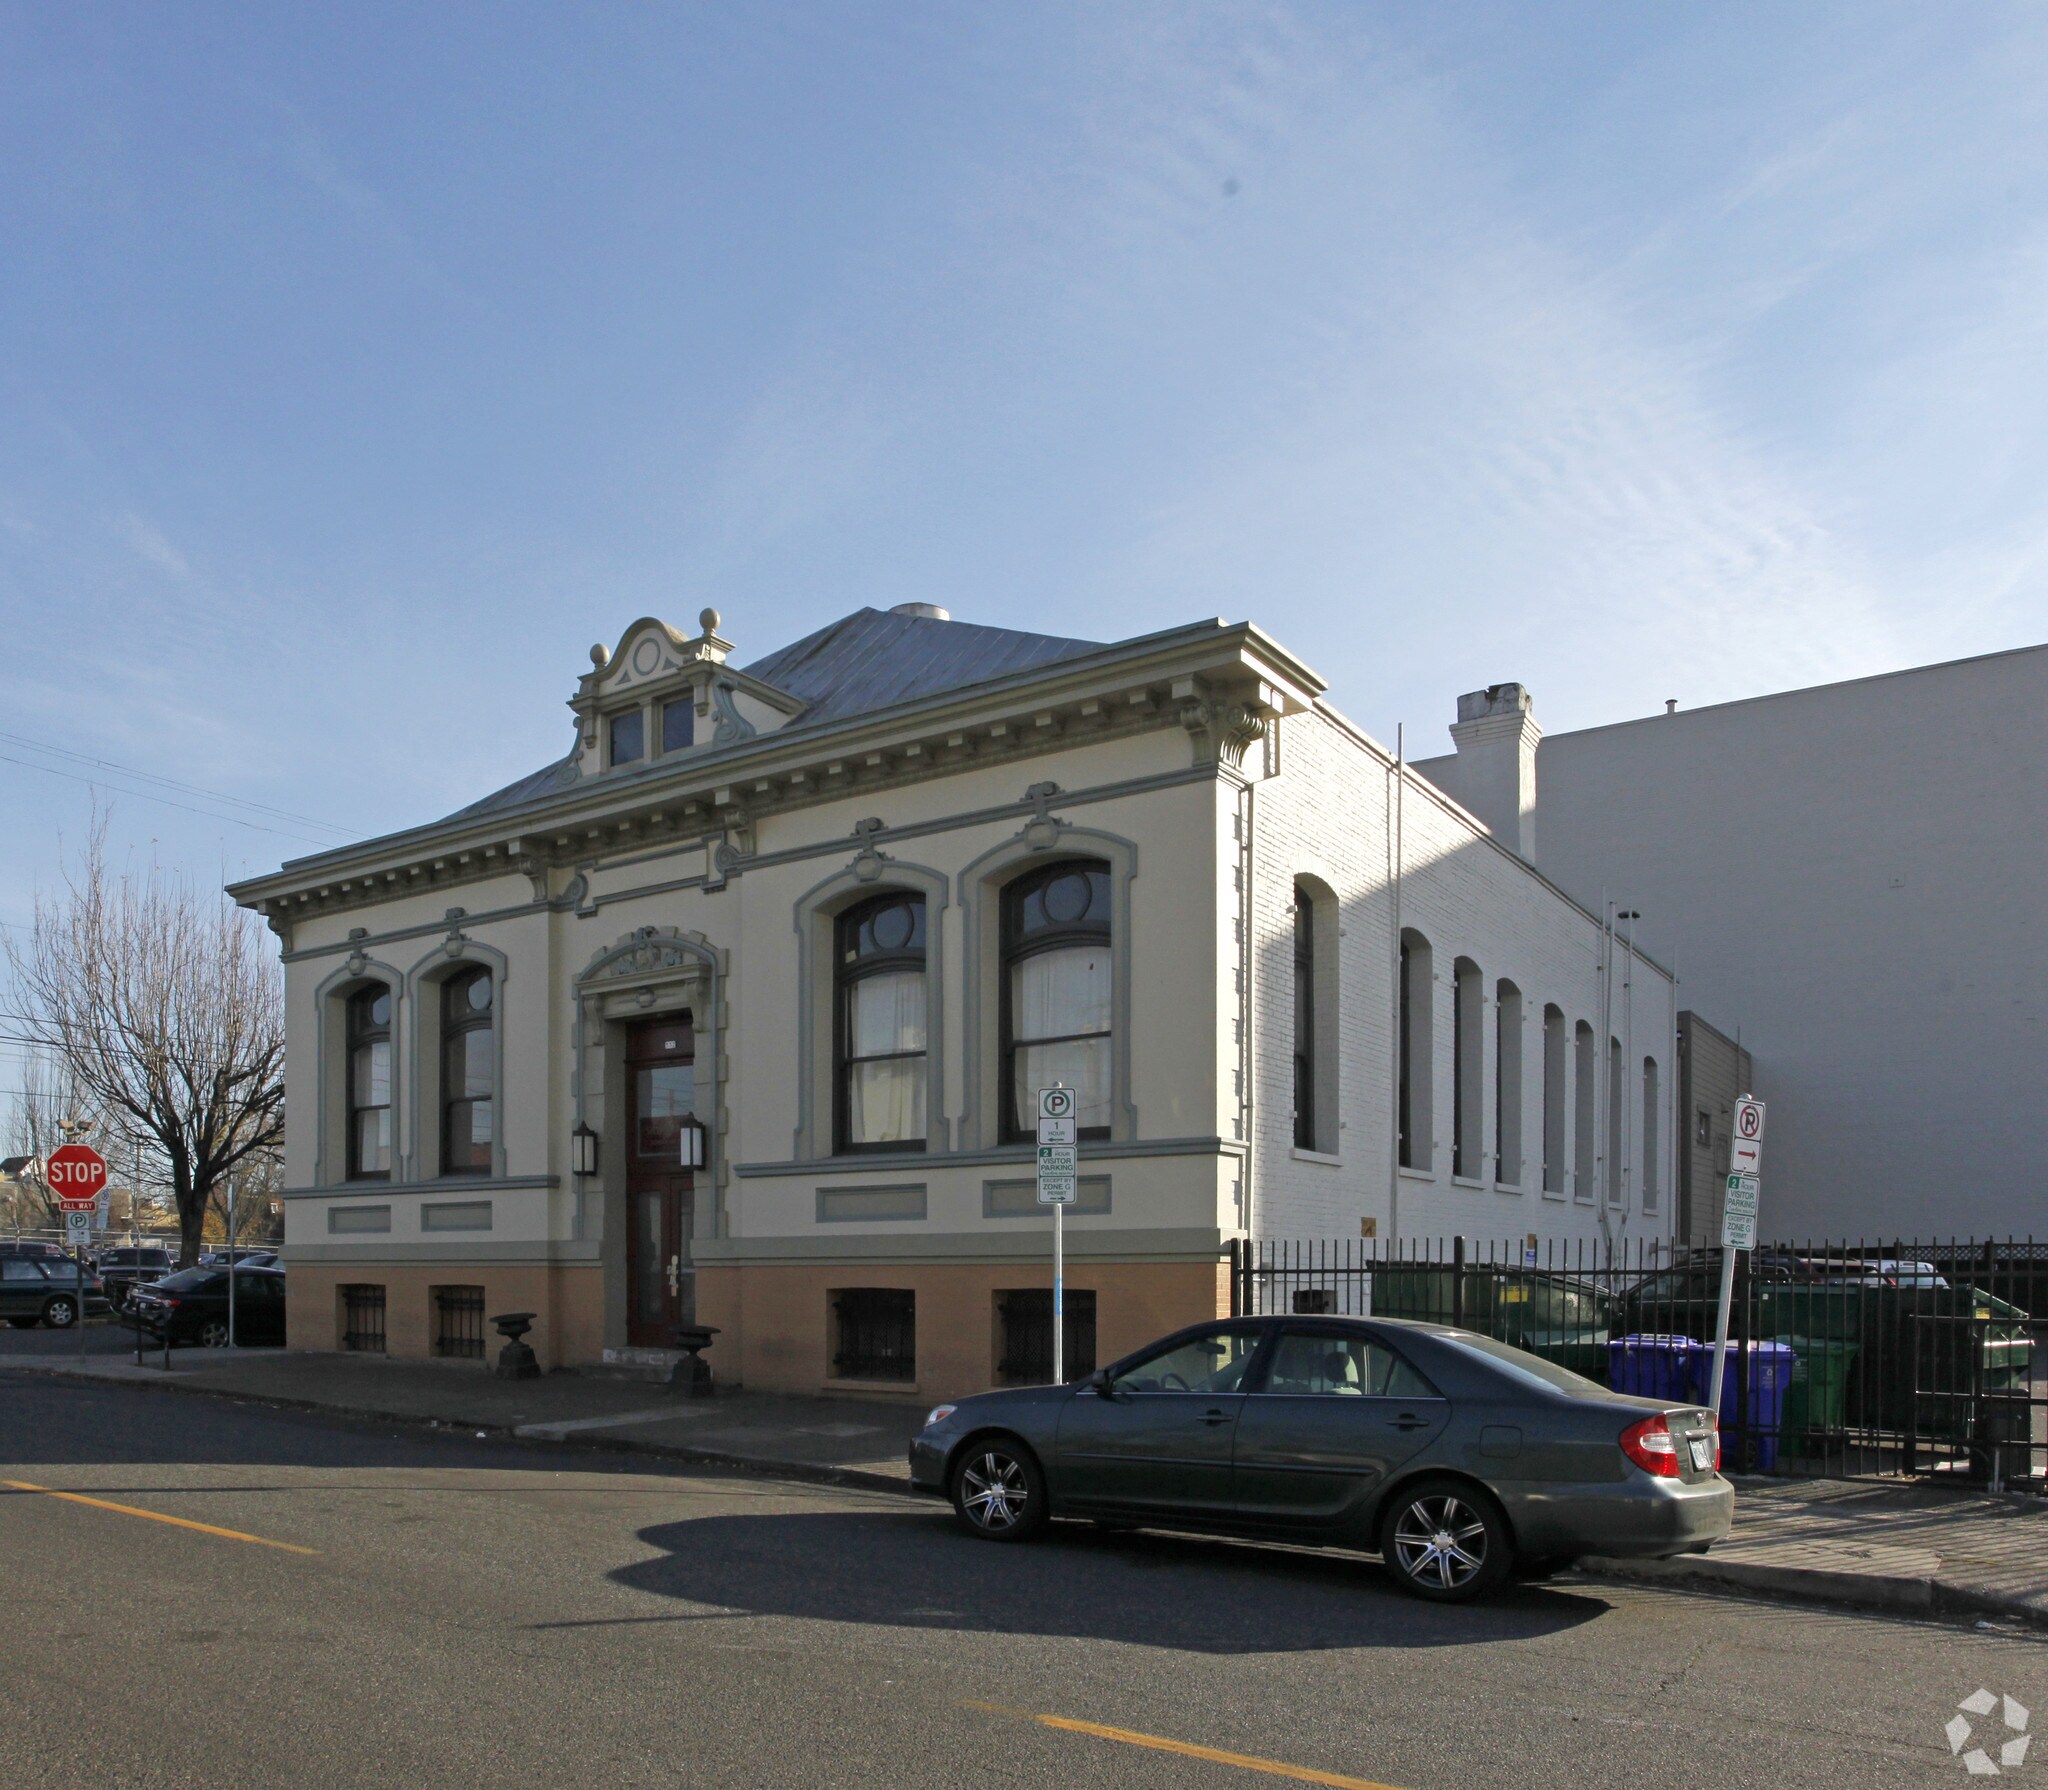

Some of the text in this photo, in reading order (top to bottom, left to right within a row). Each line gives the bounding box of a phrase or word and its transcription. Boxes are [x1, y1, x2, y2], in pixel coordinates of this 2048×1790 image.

[1051, 1096, 1065, 1112] P
[1054, 1121, 1059, 1130] 1
[51, 1162, 103, 1183] STOP
[1731, 1179, 1737, 1188] 2
[1730, 1190, 1755, 1200] VISITOR
[1728, 1198, 1756, 1209] PARKING
[75, 1217, 83, 1226] P
[1728, 1222, 1744, 1232] ZONE
